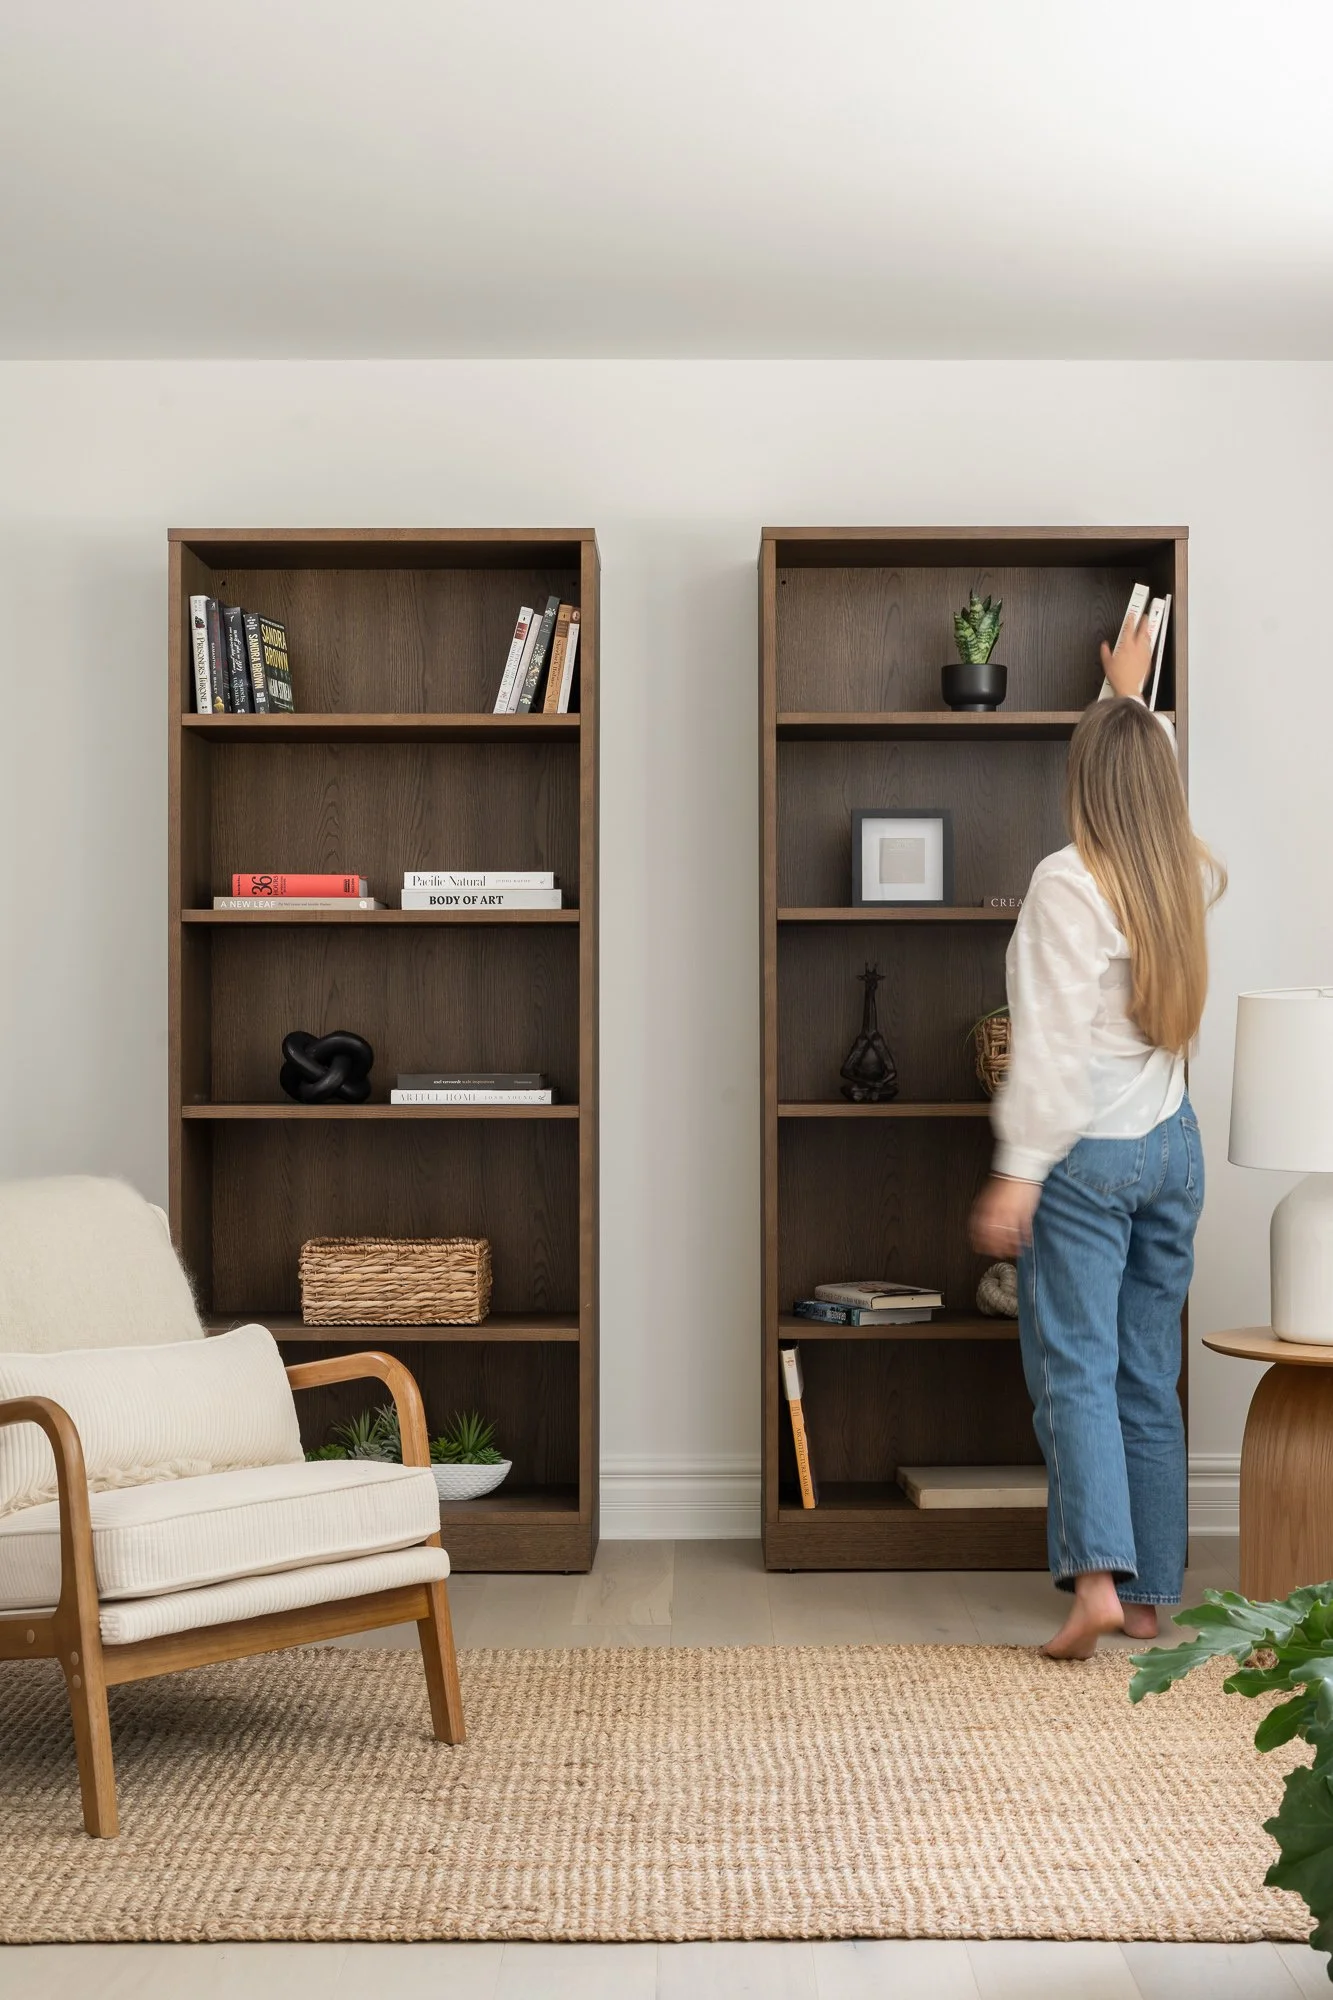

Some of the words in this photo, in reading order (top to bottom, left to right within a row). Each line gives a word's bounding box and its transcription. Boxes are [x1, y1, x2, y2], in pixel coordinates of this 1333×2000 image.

[261, 623, 287, 651] SANDRA
[248, 633, 261, 663] SANDRA
[264, 645, 289, 672] BROWN
[252, 662, 265, 689] BROWN
[251, 875, 273, 896] 36
[412, 875, 446, 887] Pacific
[449, 875, 486, 887] Natural
[220, 900, 227, 908] A
[229, 900, 251, 908] NEW
[253, 900, 277, 908] LEAF
[429, 895, 460, 905] BODY
[462, 895, 479, 905] OF
[480, 895, 504, 905] ART
[990, 898, 1023, 907] CREA
[446, 1093, 476, 1101] HOME
